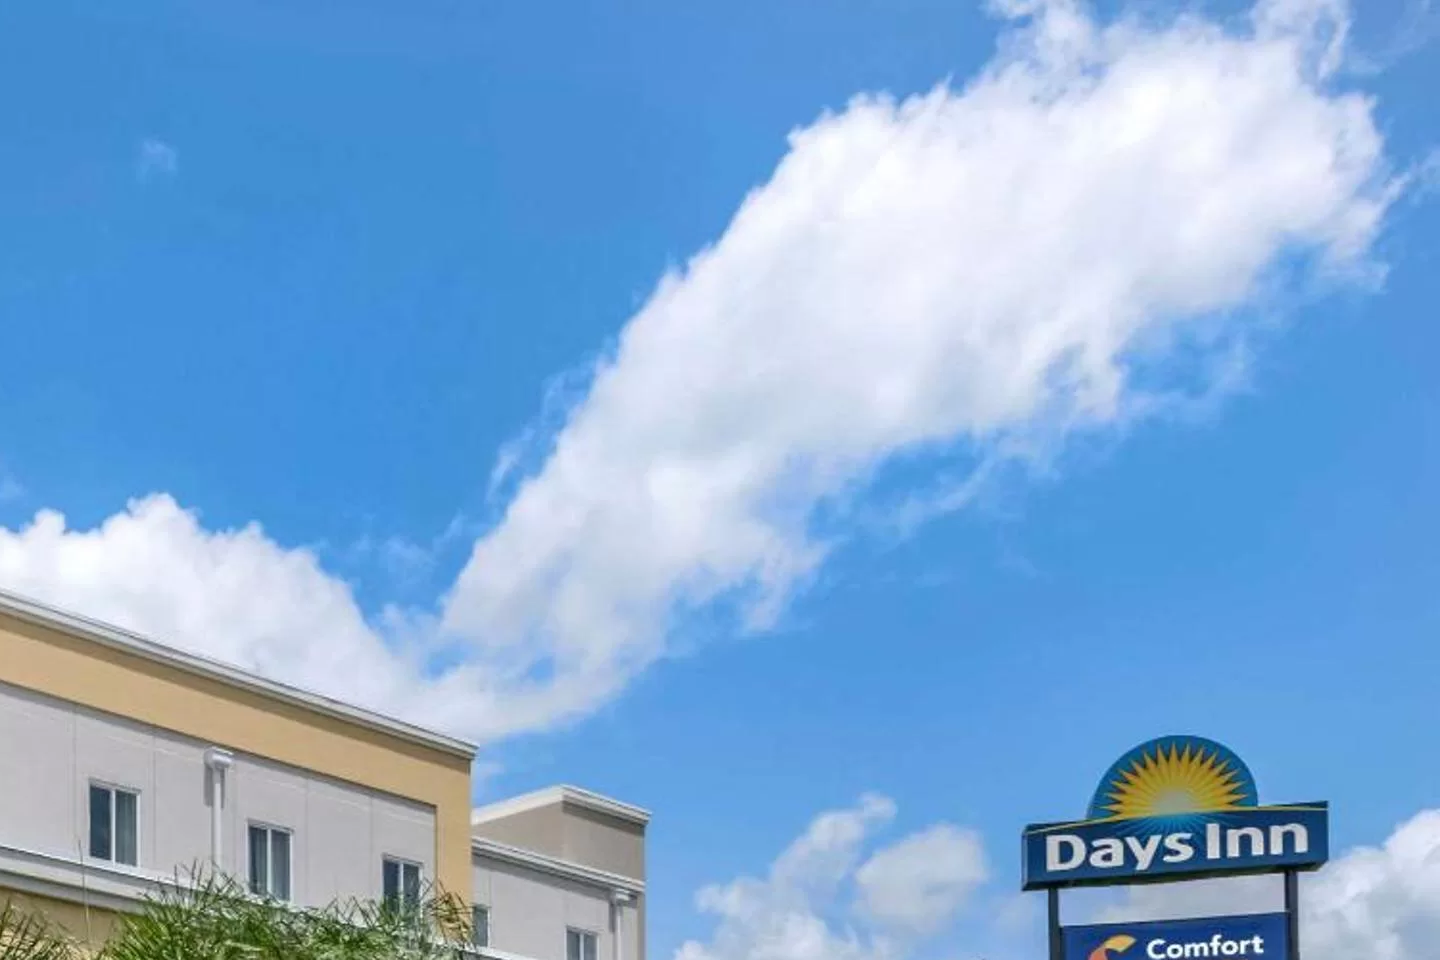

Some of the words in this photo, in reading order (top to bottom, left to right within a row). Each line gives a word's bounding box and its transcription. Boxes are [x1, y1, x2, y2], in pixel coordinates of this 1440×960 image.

[1046, 832, 1195, 871] Days
[1205, 822, 1309, 860] Inn
[1146, 934, 1264, 960] Comfort
